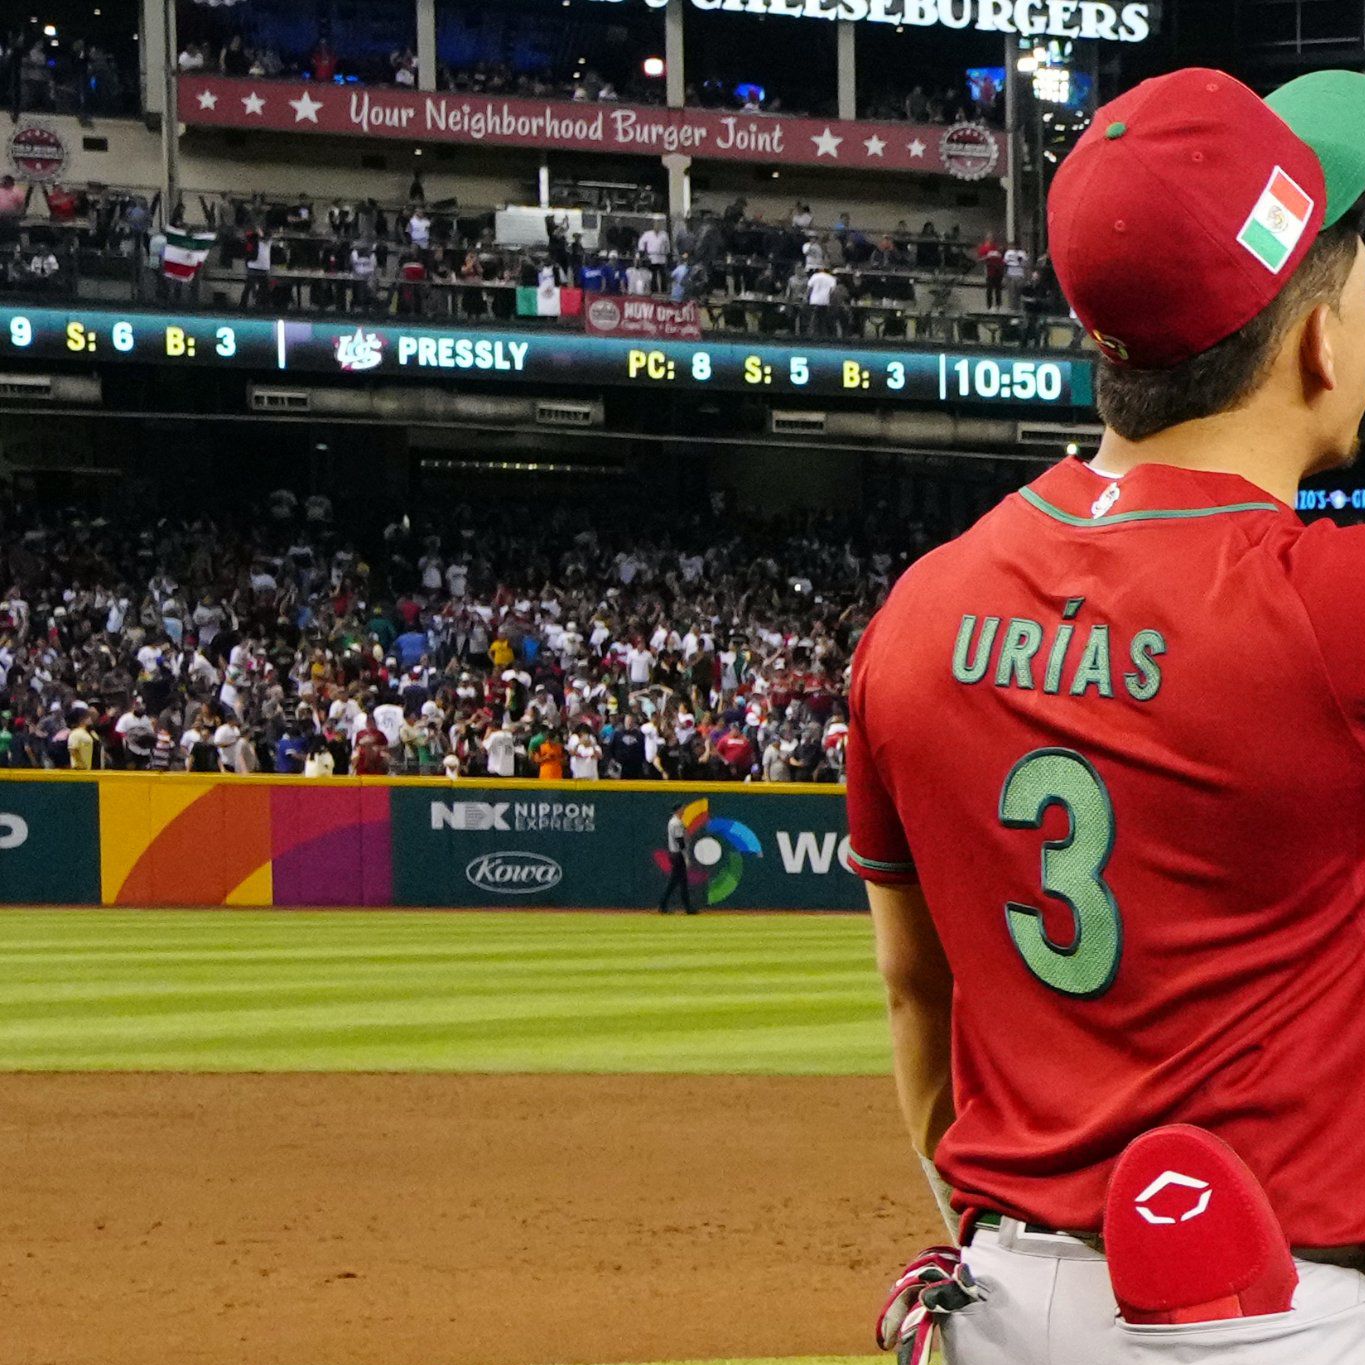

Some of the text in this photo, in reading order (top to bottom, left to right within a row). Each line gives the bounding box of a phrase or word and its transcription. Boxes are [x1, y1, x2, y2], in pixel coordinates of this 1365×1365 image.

[350, 91, 784, 153] Your Neighborhood Burger Joint
[10, 316, 32, 347] 9
[66, 322, 96, 352] S:
[112, 321, 134, 351] 6
[166, 326, 195, 357] B:
[215, 326, 236, 357] 3
[398, 336, 529, 371] PRESSLY
[628, 350, 675, 380] PC:
[691, 351, 713, 381] 8
[744, 355, 772, 384] S:
[789, 356, 810, 385] 5
[843, 360, 871, 389] B:
[886, 362, 906, 390] 3
[954, 359, 1062, 401] 10:50
[951, 597, 1167, 701] URÍAS
[515, 803, 594, 818] NIPPON
[515, 817, 595, 832] EXPRESS
[475, 858, 558, 883] Kowa
[998, 747, 1123, 998] 3
